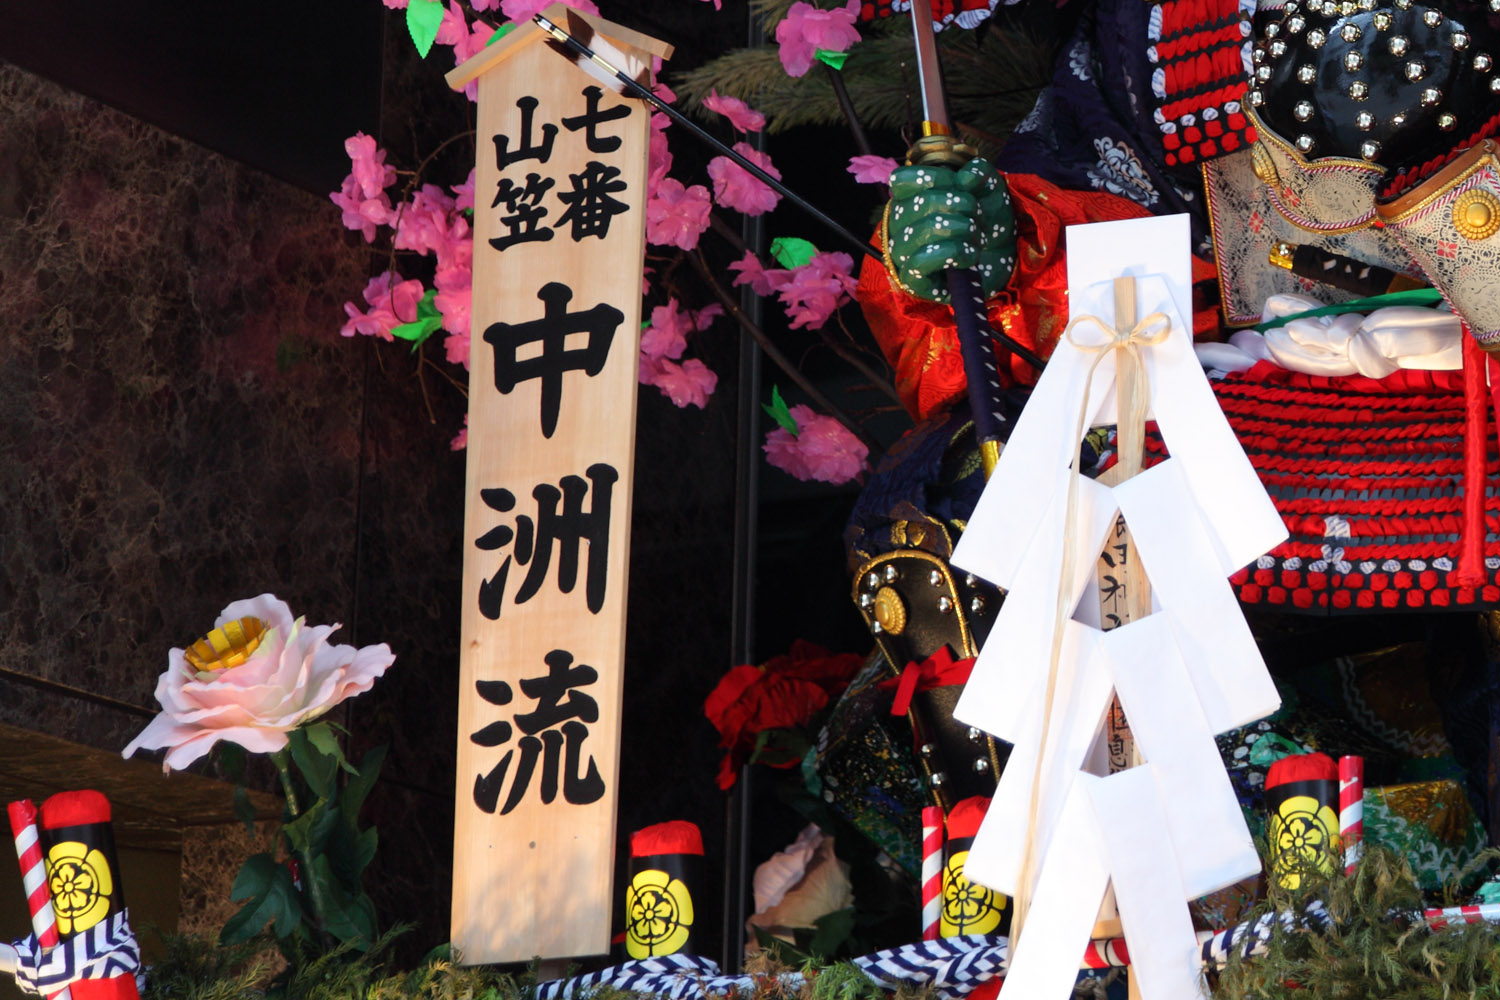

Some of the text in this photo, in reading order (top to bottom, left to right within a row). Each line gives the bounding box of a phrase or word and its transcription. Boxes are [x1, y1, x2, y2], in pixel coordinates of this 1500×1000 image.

[488, 95, 560, 252] 山笠
[554, 85, 632, 243] 七番
[470, 281, 625, 818] 中洲流
